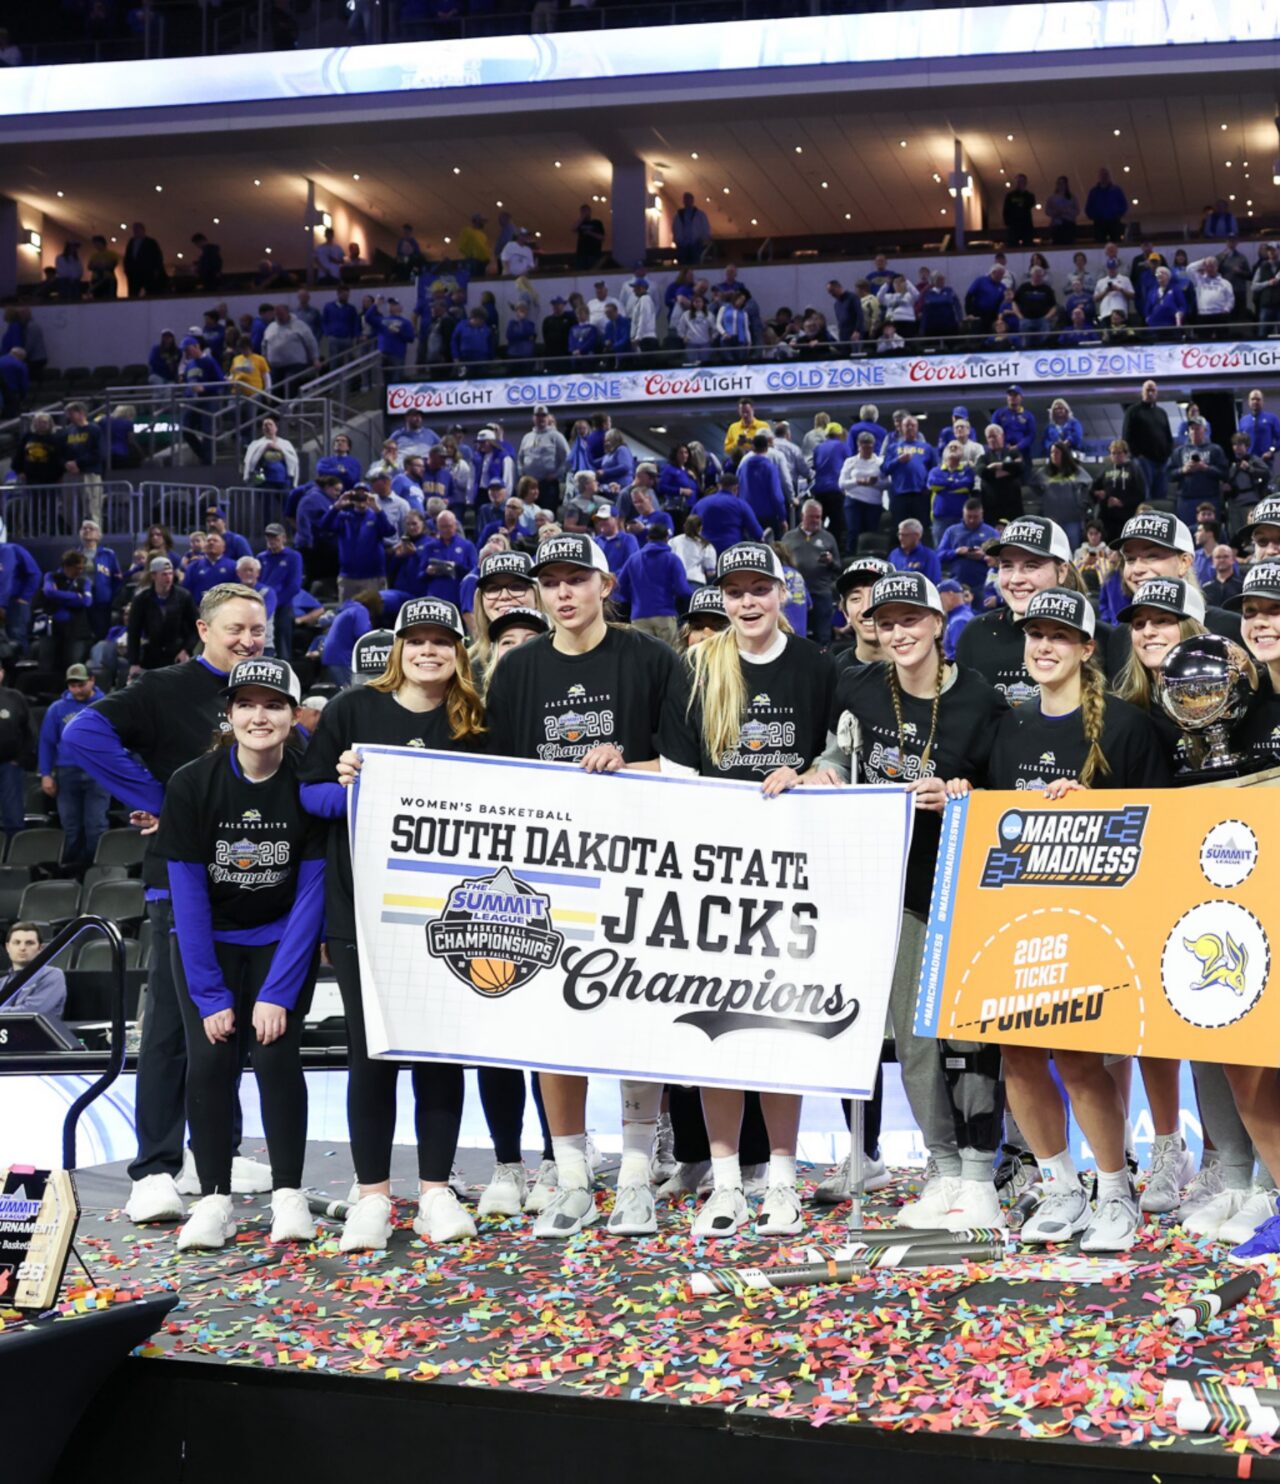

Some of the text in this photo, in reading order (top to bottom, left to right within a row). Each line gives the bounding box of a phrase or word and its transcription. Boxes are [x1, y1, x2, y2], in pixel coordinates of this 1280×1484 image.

[1034, 353, 1155, 377] COLD ZONE
[1180, 346, 1240, 370] Coors
[766, 365, 885, 390] COLD ZONE
[908, 359, 1020, 382] Coors LIGHT
[506, 379, 622, 403] COLD ZONE
[644, 372, 753, 395] Coors LIGHT
[388, 387, 494, 409] Coors LIGHT
[723, 552, 767, 564] CHAMPS
[694, 594, 723, 604] CHAM
[1031, 600, 1076, 614] CHAMPS
[407, 605, 452, 620] CHAMPS
[361, 653, 388, 663] CHAM
[235, 664, 282, 679] CHAMPS
[400, 796, 572, 821] WOMEN'S BASKETBALL
[1021, 815, 1104, 843] MARCH
[391, 815, 808, 889] SOUTH DAKOTA STATE
[1027, 847, 1137, 875] MADNESS
[1206, 848, 1251, 860] SUMMIT
[453, 892, 544, 915] SUMMIT
[474, 912, 525, 923] LEAGUE
[601, 887, 818, 959] JACKS
[467, 924, 526, 937] BASKETBALL
[435, 933, 552, 961] CHAMPIONSHIPS
[1013, 934, 1068, 965] 2026
[560, 946, 856, 1015] Champions
[924, 933, 944, 1027] #MARCHMADNESS
[1014, 963, 1068, 989] TICKET
[980, 984, 1104, 1035] PUNCHED
[0, 1201, 39, 1213] UMMIT
